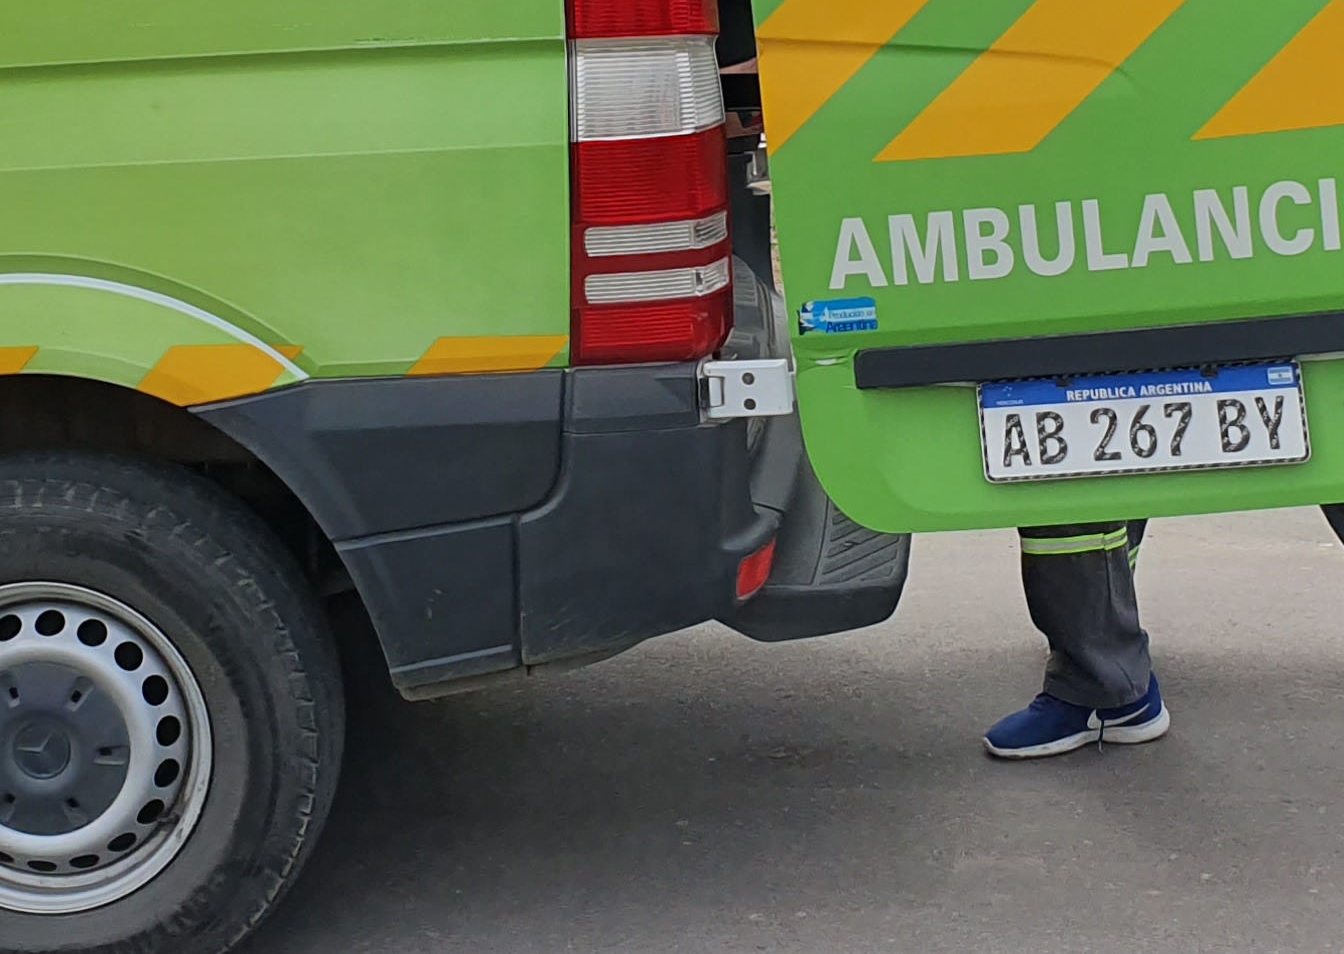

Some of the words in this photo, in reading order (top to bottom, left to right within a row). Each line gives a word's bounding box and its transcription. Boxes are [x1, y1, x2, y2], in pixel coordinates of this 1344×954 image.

[1066, 386, 1136, 401] REPUBLICA
[1140, 381, 1212, 396] ARGENTINA
[1003, 411, 1068, 467] AB
[1090, 399, 1192, 462] 267
[1217, 395, 1285, 453] BY
